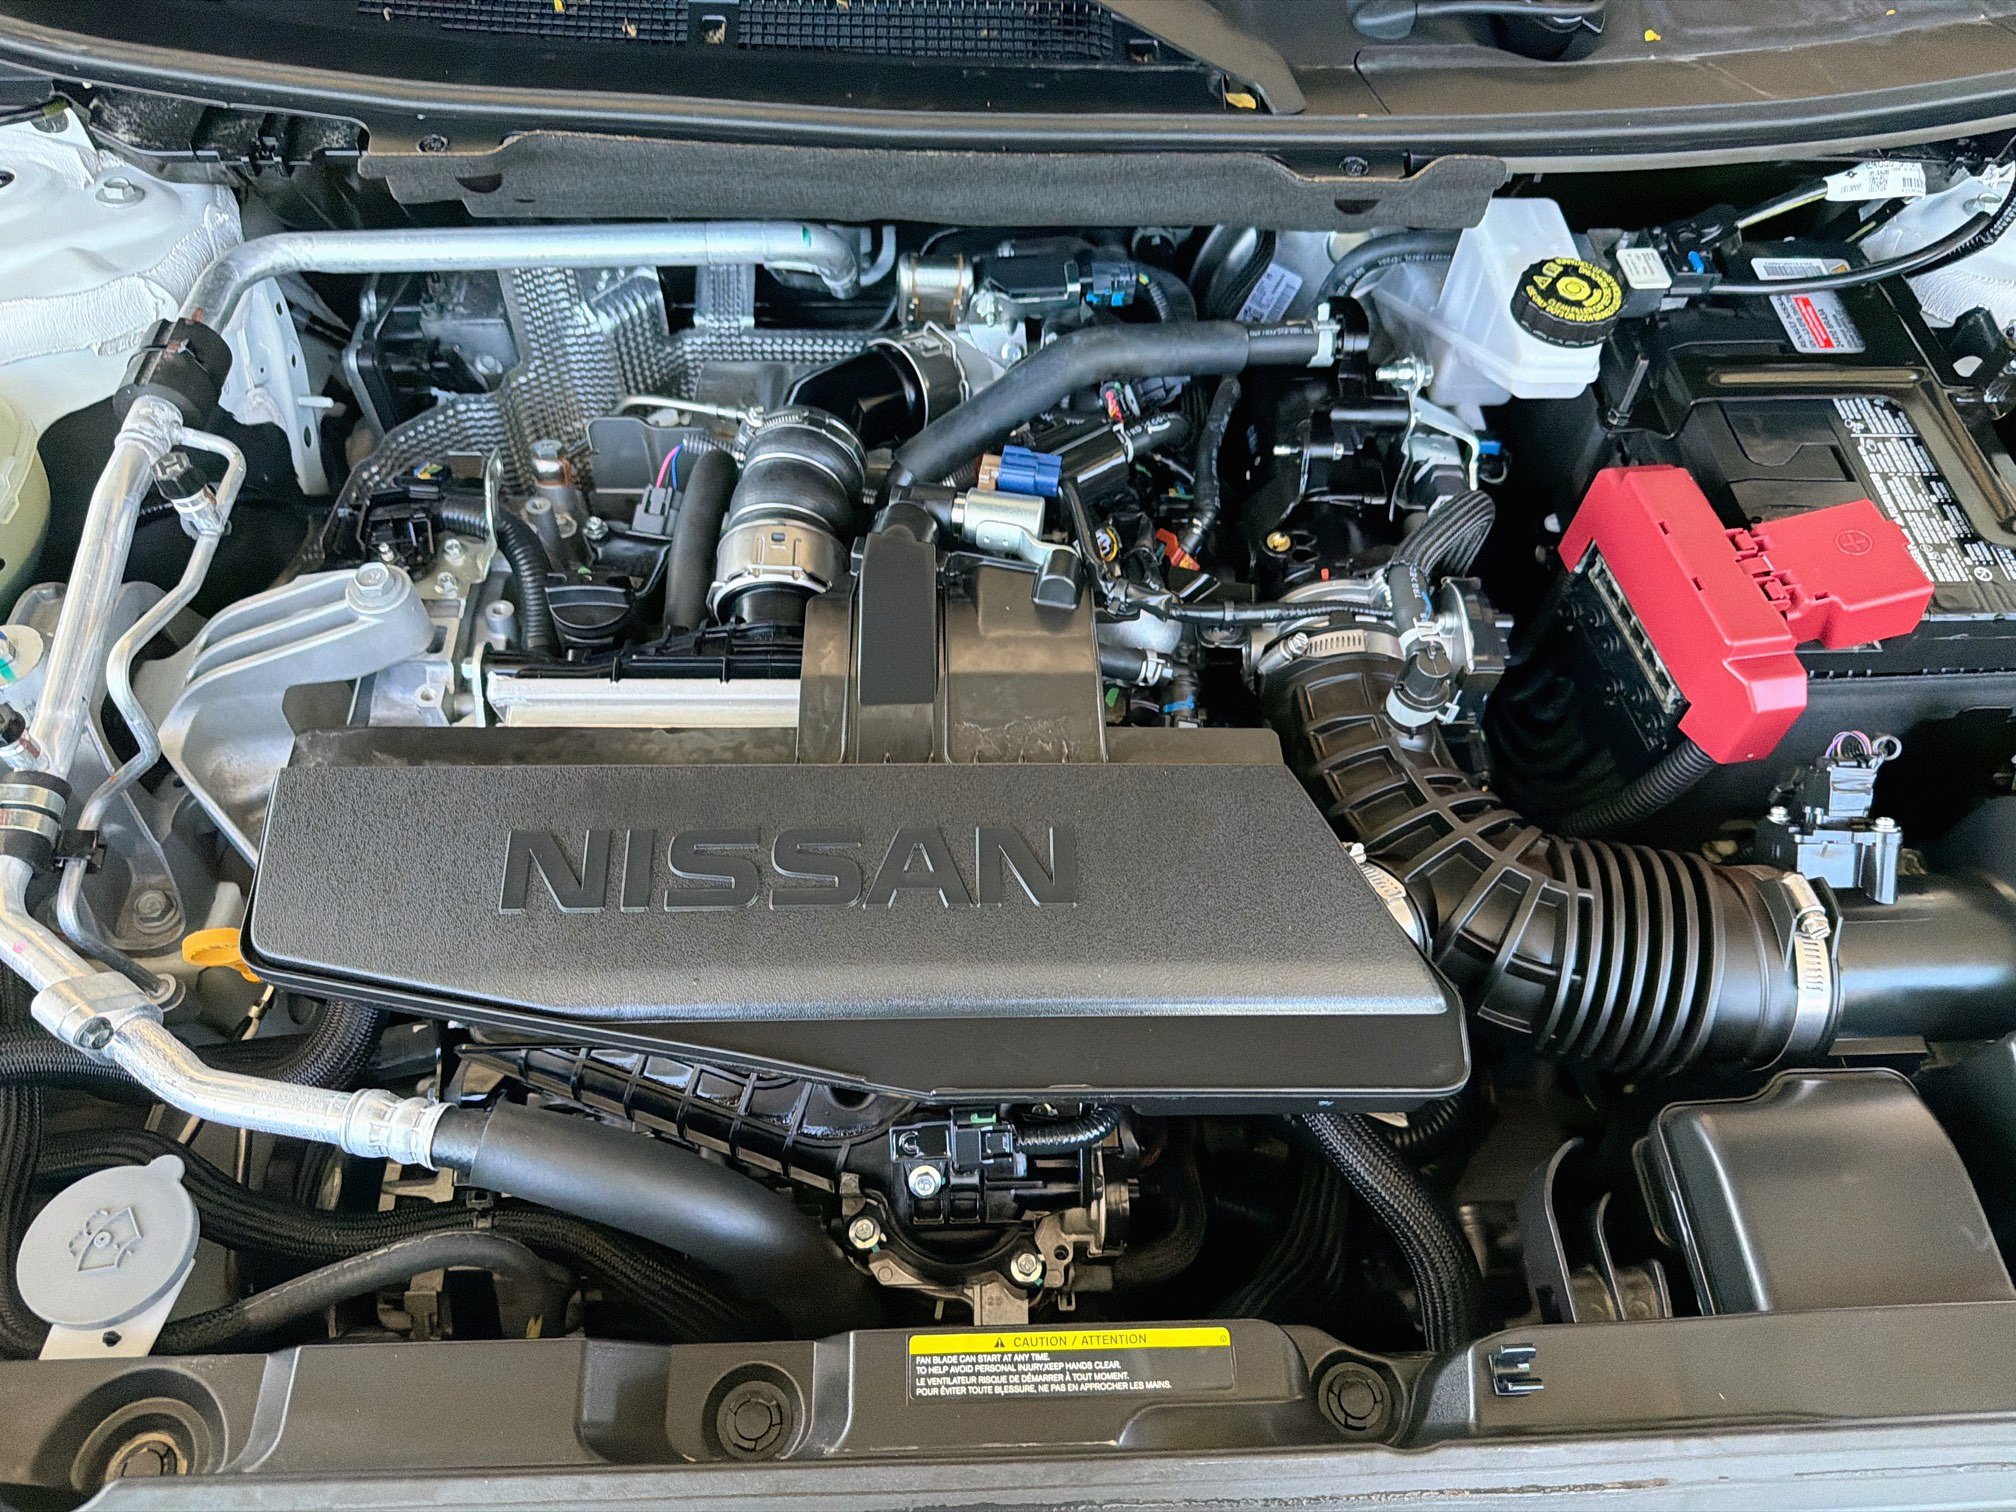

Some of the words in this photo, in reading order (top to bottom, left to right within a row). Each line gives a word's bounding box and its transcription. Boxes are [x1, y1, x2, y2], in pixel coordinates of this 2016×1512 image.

[499, 826, 1078, 914] NISSAN
[1013, 1336, 1067, 1348] CAUTION
[1071, 1336, 1078, 1346] /
[1081, 1334, 1147, 1346] ATTENTION
[916, 1355, 931, 1365] FAN
[932, 1355, 958, 1364] BLADE
[959, 1354, 976, 1364] CAN
[977, 1354, 1000, 1363] START
[1002, 1354, 1013, 1362] AT
[1014, 1353, 1029, 1362] ANY
[1030, 1352, 1050, 1362] TIME.
[916, 1366, 927, 1375] TO
[928, 1365, 948, 1374] HELP
[950, 1364, 974, 1374] AVOID
[974, 1364, 1016, 1373] PERSONAL
[1065, 1361, 1093, 1370] HANDS
[1094, 1361, 1121, 1369] CLEAR.
[916, 1377, 926, 1386] LE
[927, 1376, 977, 1386] VENTILATEUR
[978, 1375, 1008, 1384] RISQUE
[1010, 1374, 1020, 1383] DE
[1021, 1372, 1064, 1383] DÉMARRER
[1072, 1372, 1093, 1381] TOUT
[1095, 1372, 1129, 1380] MOMENT.
[916, 1387, 938, 1396] POUR
[940, 1384, 966, 1395] ÉVITER
[968, 1386, 993, 1394] TOUTE
[994, 1385, 1037, 1396] BLESSURE,
[1038, 1384, 1049, 1392] NE
[1050, 1383, 1066, 1392] PAS
[1068, 1382, 1078, 1391] EN
[1080, 1382, 1128, 1390] APPROCHER
[1129, 1381, 1144, 1390] LES
[1146, 1380, 1172, 1389] MAINS.
